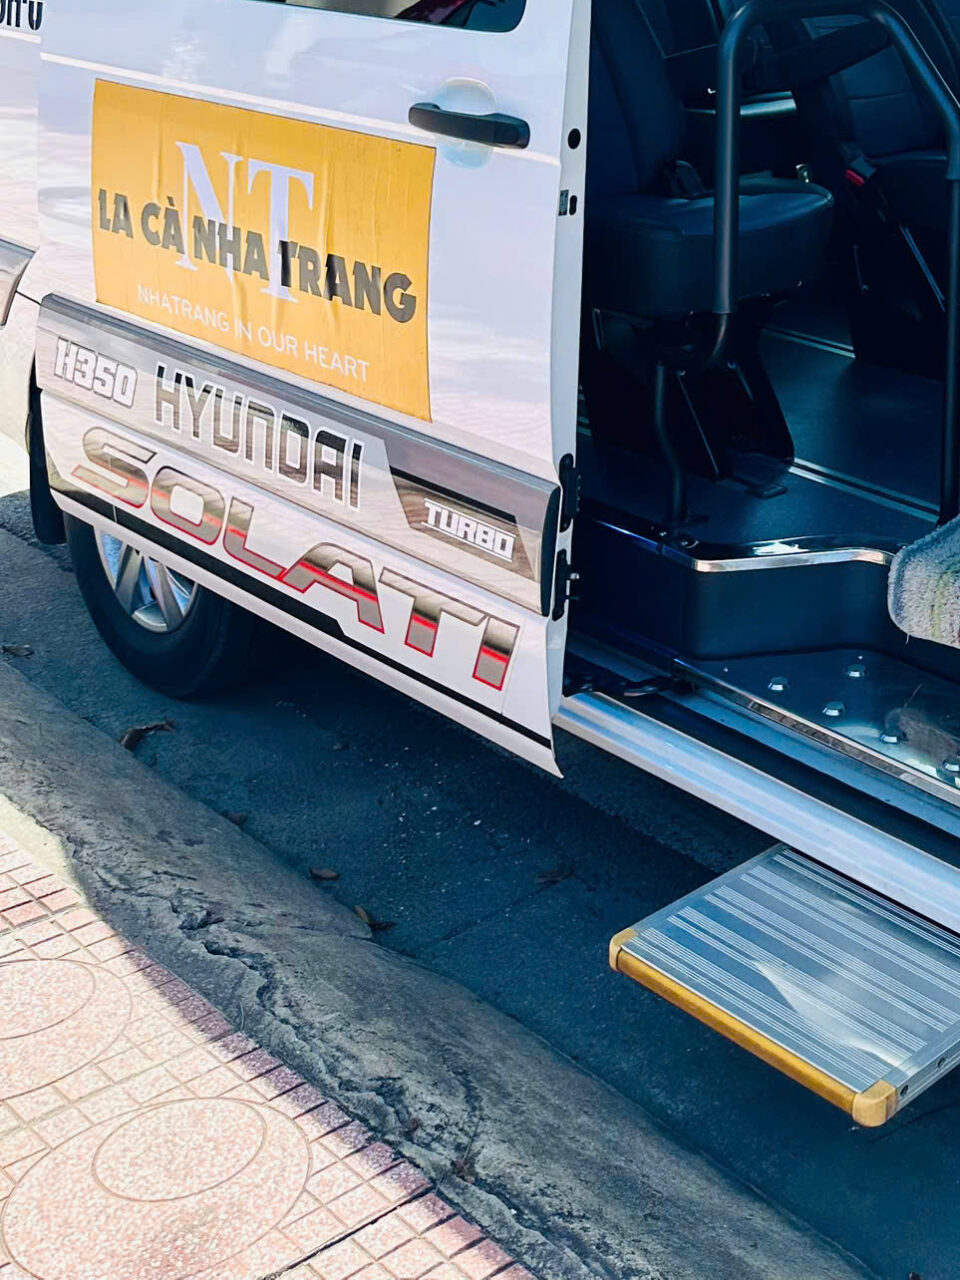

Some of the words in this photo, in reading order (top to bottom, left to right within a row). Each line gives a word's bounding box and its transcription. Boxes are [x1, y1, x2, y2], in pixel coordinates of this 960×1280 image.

[98, 188, 134, 239] LA
[141, 195, 185, 255] CÀ
[192, 214, 270, 281] NHA
[277, 239, 417, 324] TRANG
[176, 140, 315, 303] NT
[53, 337, 139, 409] H350
[234, 317, 253, 343] IN
[257, 325, 299, 359] OUR
[304, 346, 370, 383] HEART
[154, 360, 366, 513] HYUNDAI
[71, 426, 521, 691] SOLATI
[424, 501, 518, 560] TURBO
